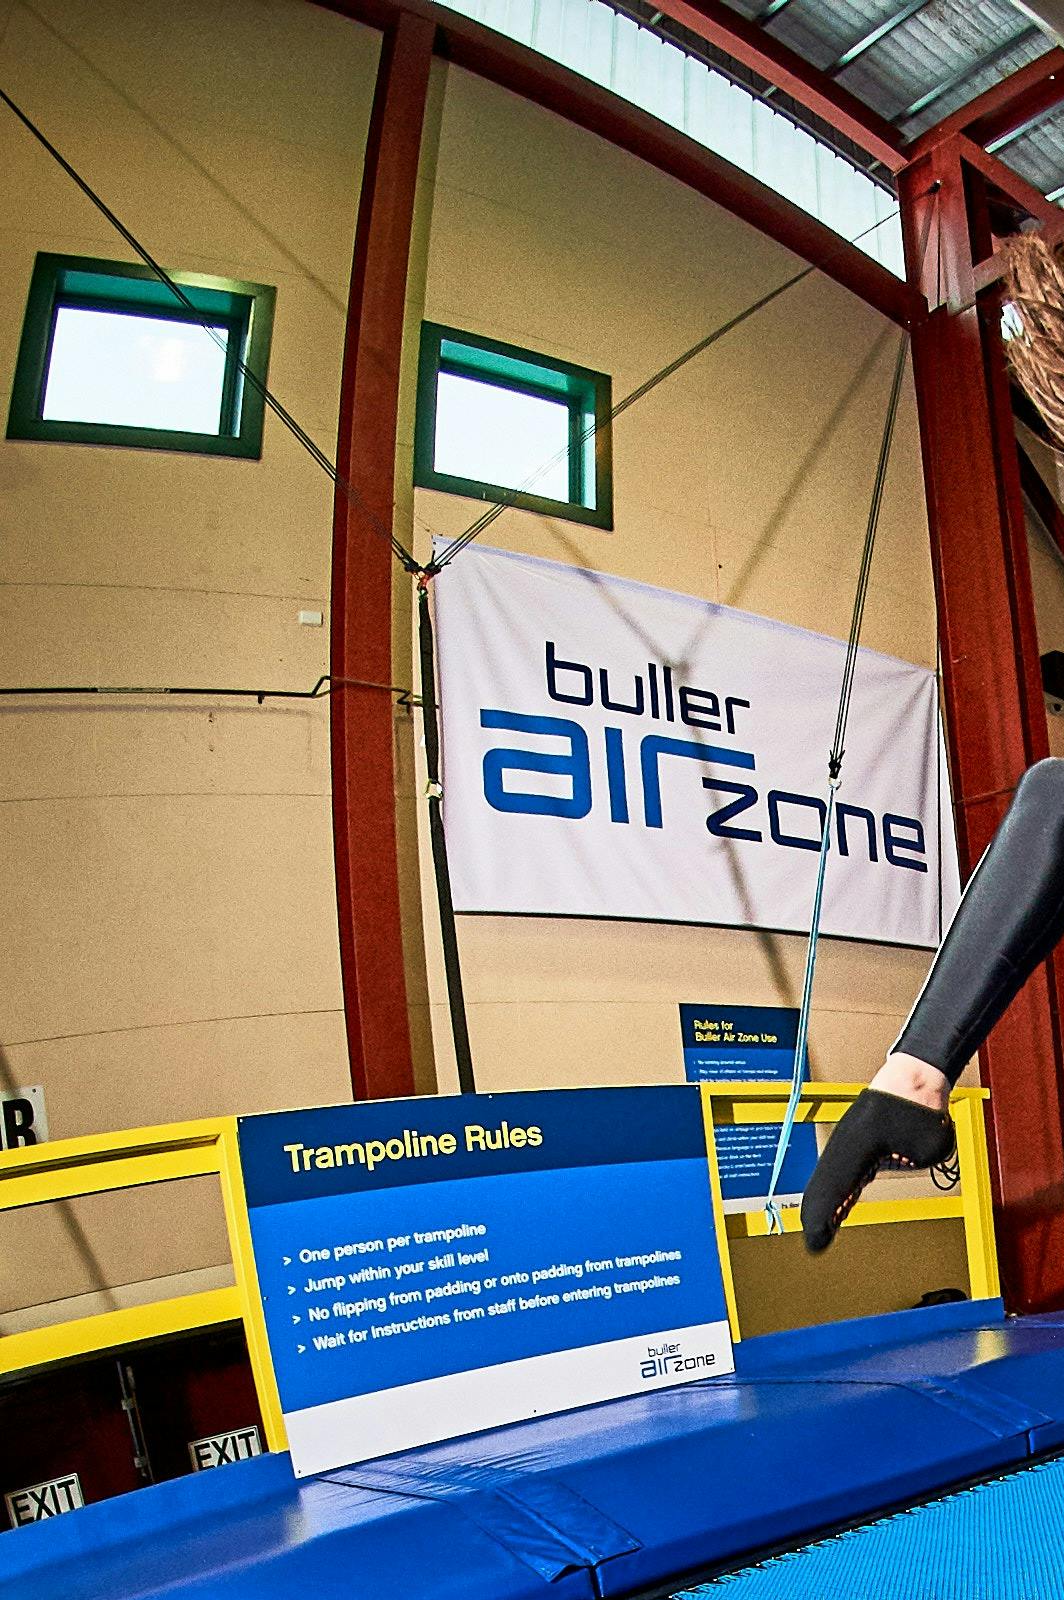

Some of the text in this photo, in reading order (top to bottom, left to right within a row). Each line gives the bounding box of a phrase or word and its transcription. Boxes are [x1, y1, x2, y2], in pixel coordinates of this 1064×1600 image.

[546, 641, 750, 734] buller
[480, 708, 929, 873] air zone
[693, 1019, 734, 1031] Rules for
[695, 1031, 778, 1044] Buller Air Zone Use
[284, 1121, 543, 1173] Trampoline Rules
[299, 1223, 487, 1264] One person per trampoline
[304, 1248, 489, 1293] Jump within your skill level
[308, 1249, 682, 1323] No flipping from padding or onto padding from trampolines
[312, 1332, 347, 1352] Wait
[348, 1327, 368, 1344] for
[453, 1306, 485, 1323] from
[487, 1298, 517, 1317] staff
[519, 1291, 560, 1311] before
[562, 1284, 612, 1301] entering
[614, 1274, 681, 1294] trampolines
[640, 1354, 716, 1379] air zone
[647, 1343, 681, 1358] buller
[194, 1430, 256, 1471] EXIT
[11, 1478, 76, 1528] EXIT
